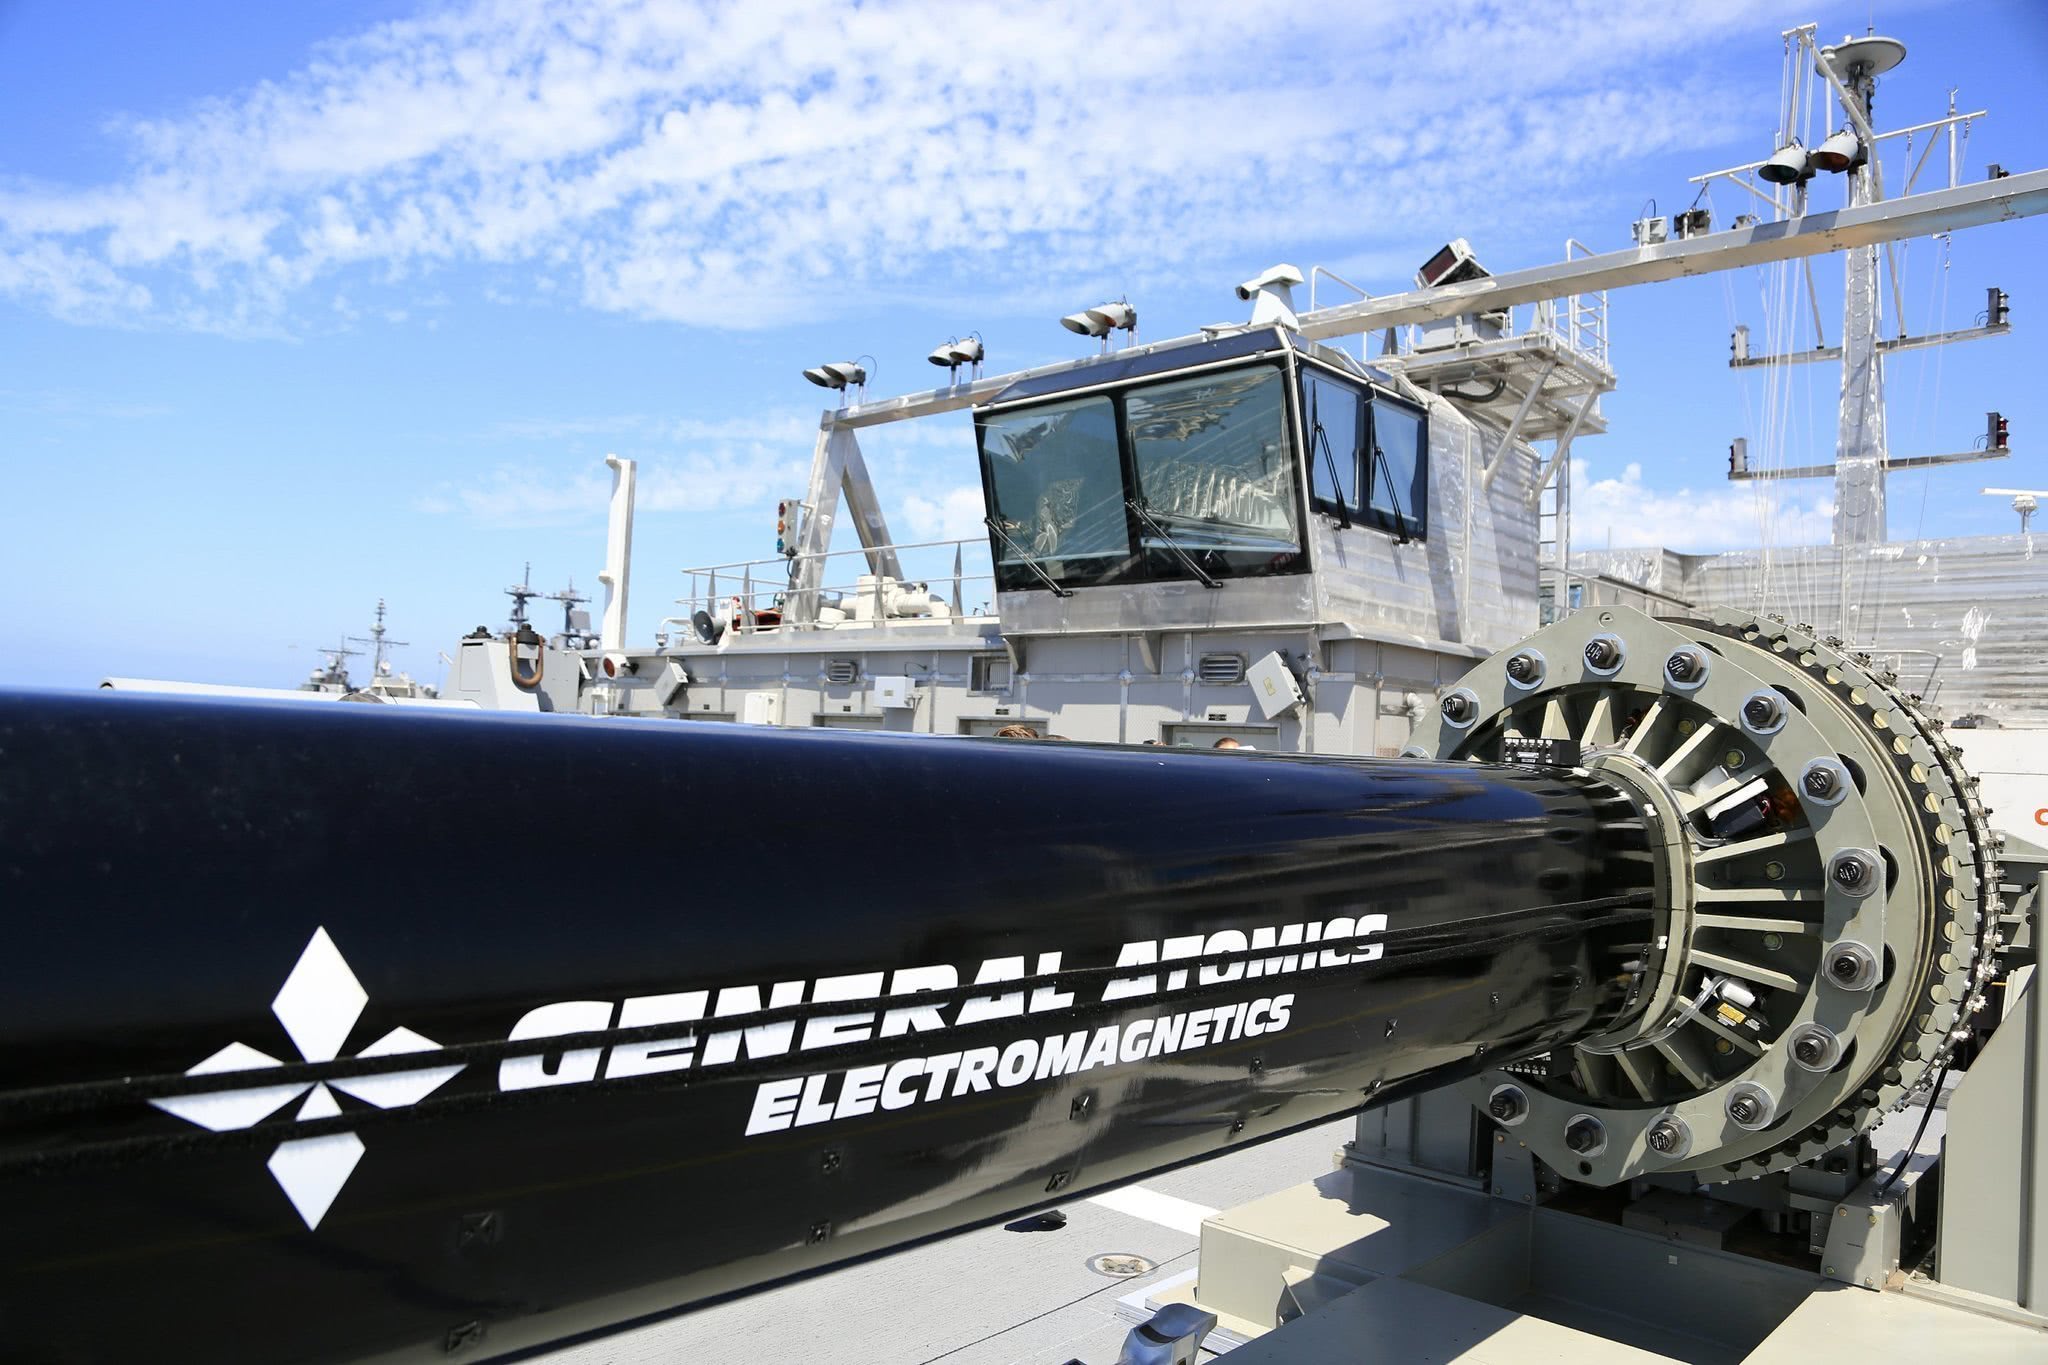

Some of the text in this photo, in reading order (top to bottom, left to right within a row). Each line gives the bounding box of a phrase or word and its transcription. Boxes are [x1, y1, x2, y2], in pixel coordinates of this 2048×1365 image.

[499, 914, 1388, 1092] GENERAL ATOMICS
[745, 994, 1295, 1136] ELECTROMAGNETICS
